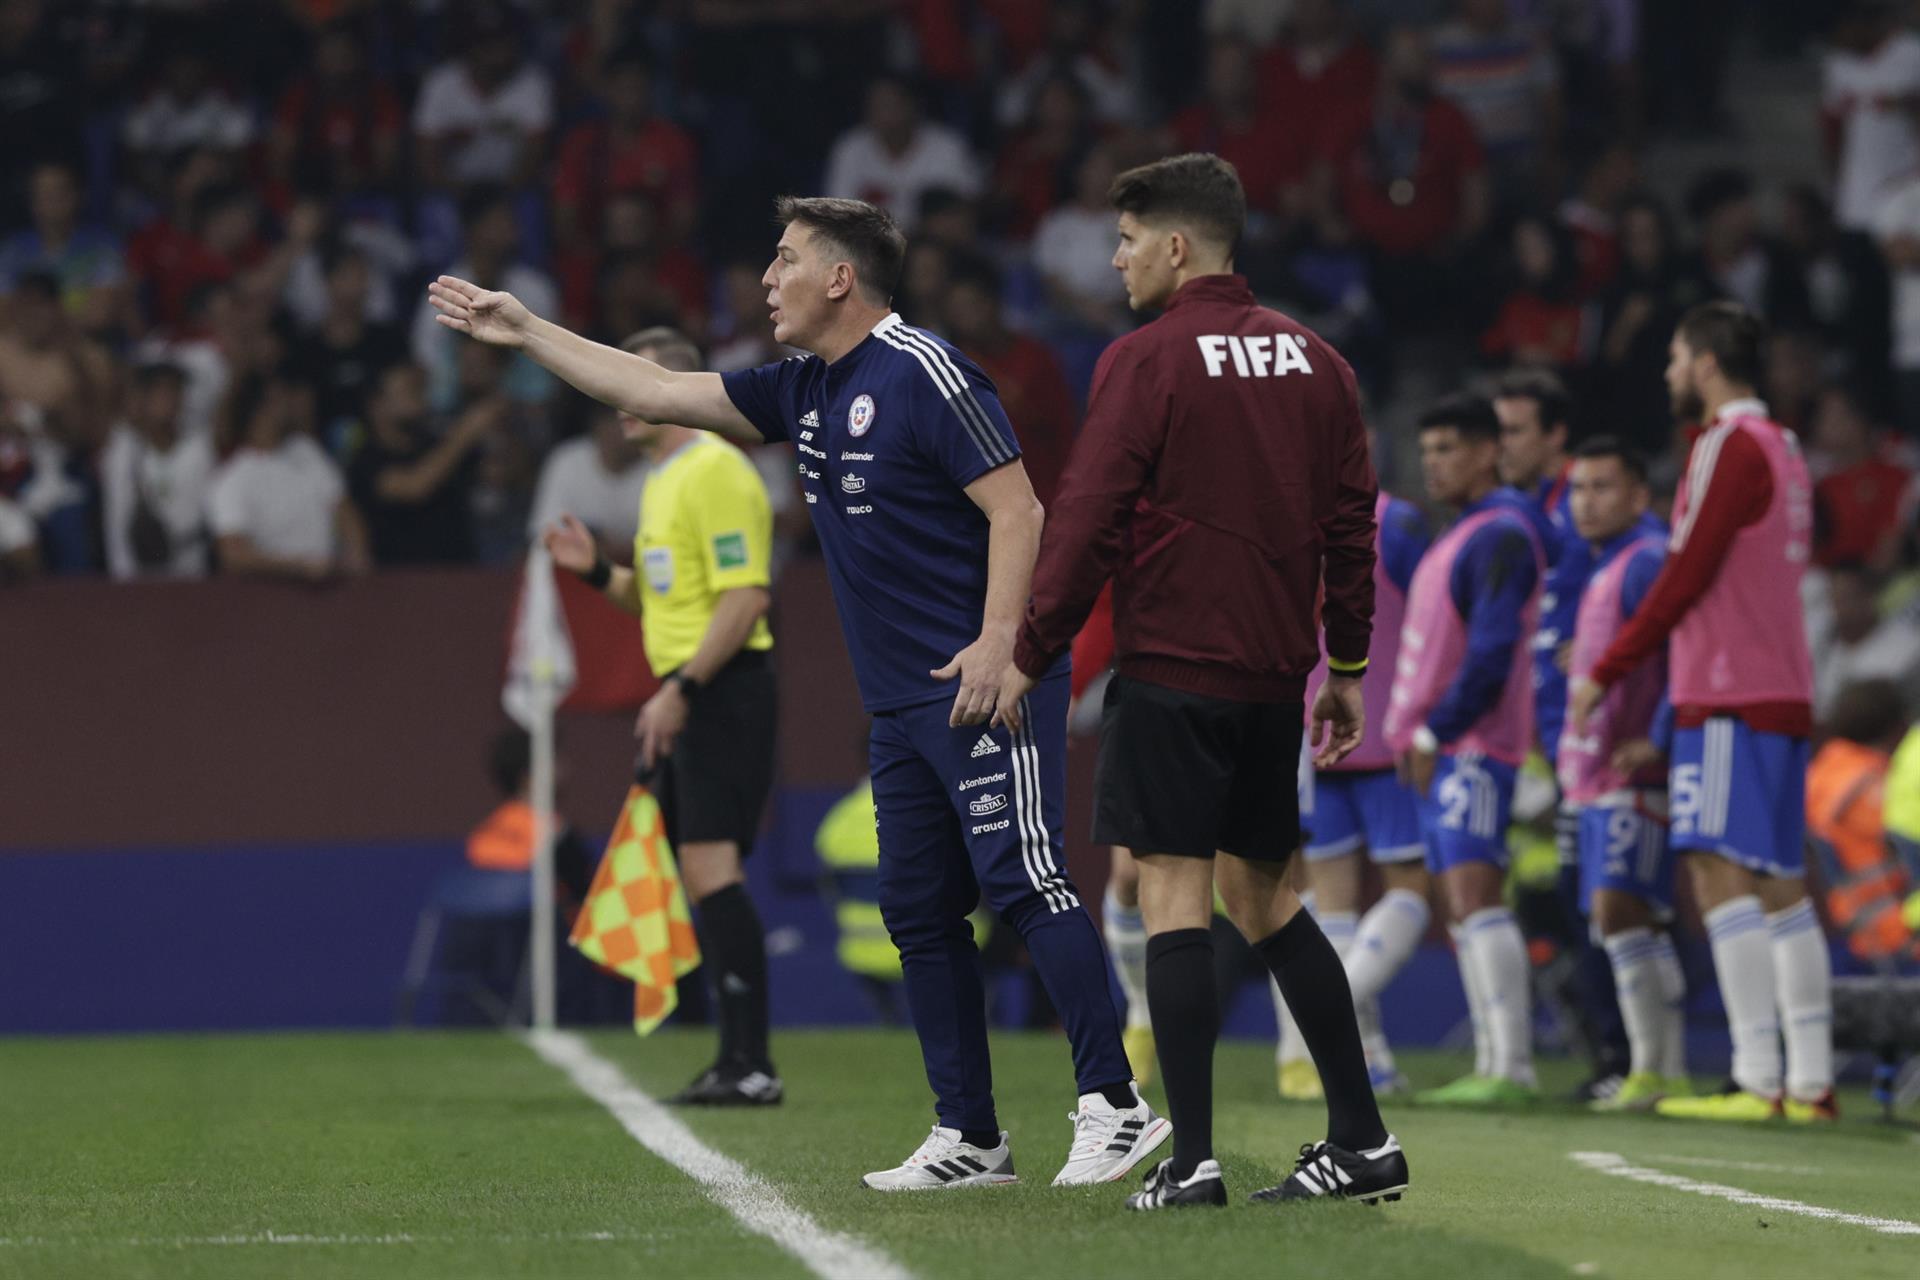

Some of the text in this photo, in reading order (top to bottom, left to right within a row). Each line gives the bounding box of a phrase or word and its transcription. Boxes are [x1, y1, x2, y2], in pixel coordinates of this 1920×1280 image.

[1196, 333, 1313, 377] FIFA
[970, 745, 1001, 758] adidas
[965, 772, 1007, 789] Santander
[972, 798, 1003, 813] CRISTAL
[972, 819, 1010, 835] arauco
